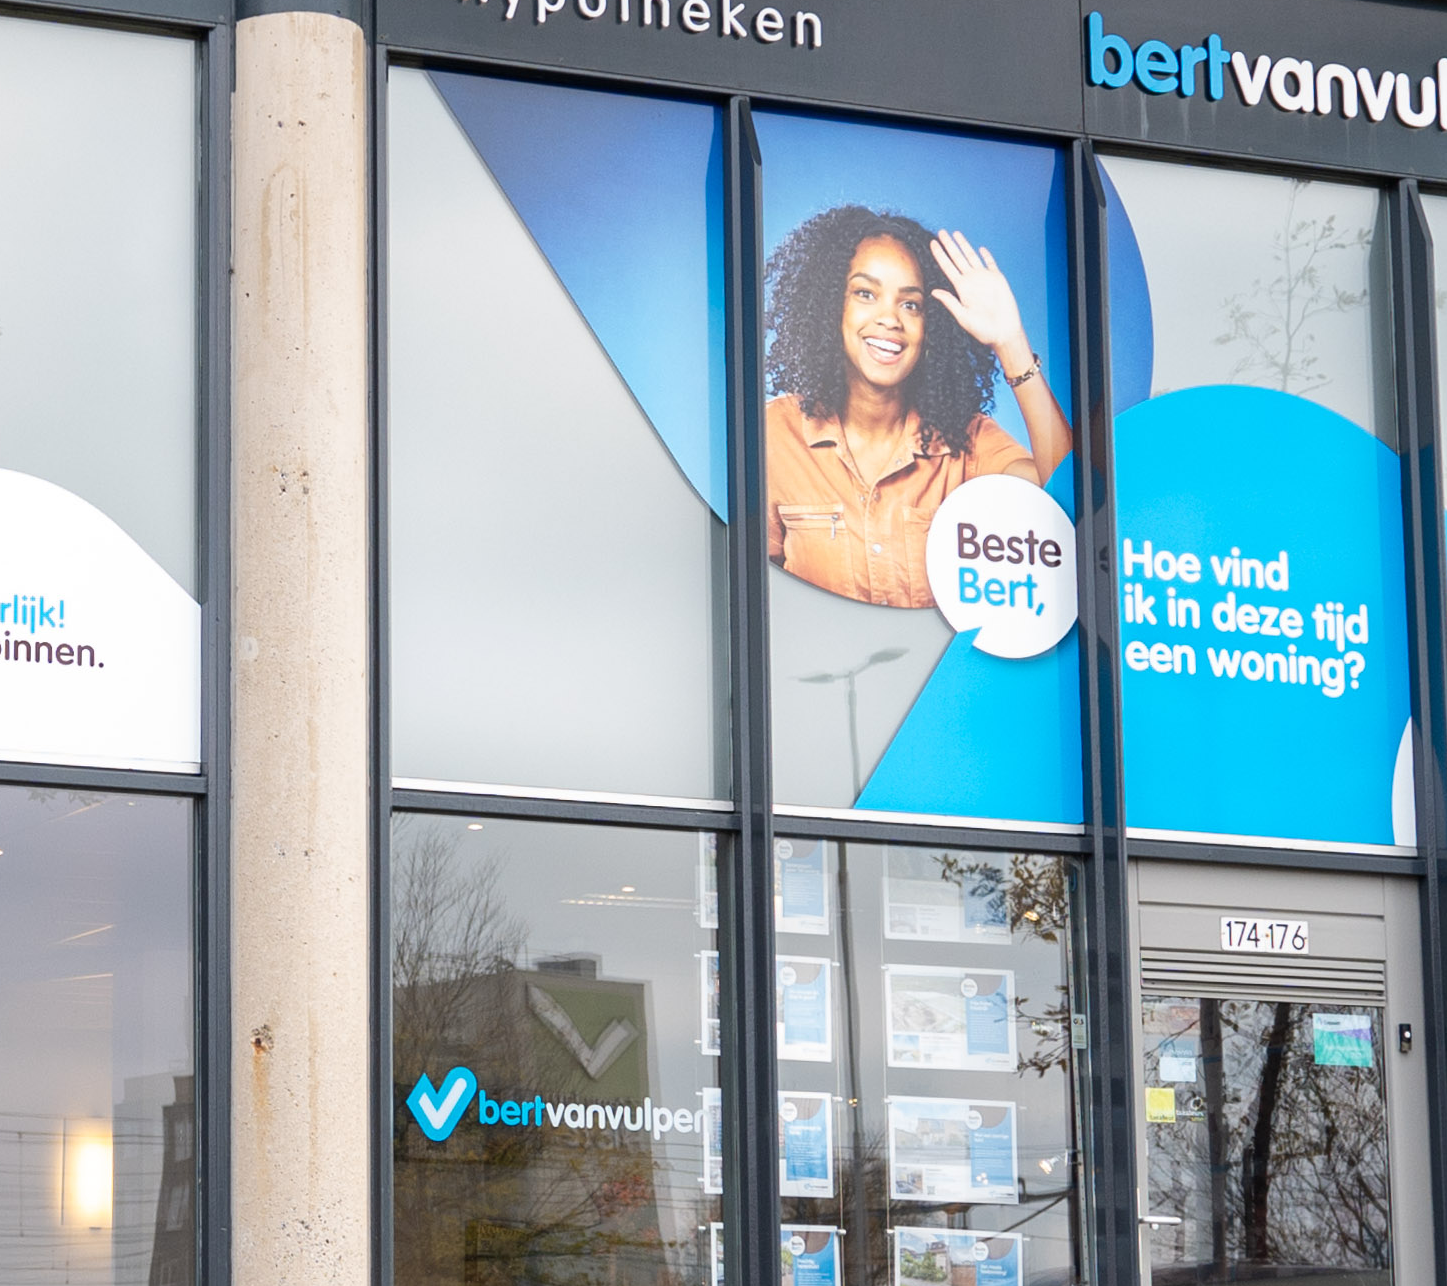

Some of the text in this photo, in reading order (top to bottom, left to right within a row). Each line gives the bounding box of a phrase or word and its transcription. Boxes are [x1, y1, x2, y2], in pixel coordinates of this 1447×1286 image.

[955, 523, 1063, 568] Beste
[1121, 539, 1289, 592] Hoe vind
[957, 565, 1047, 617] Bert,
[1124, 583, 1369, 653] ik in deze tijd
[1124, 639, 1367, 699] een woning?
[1226, 920, 1306, 951] 174 176
